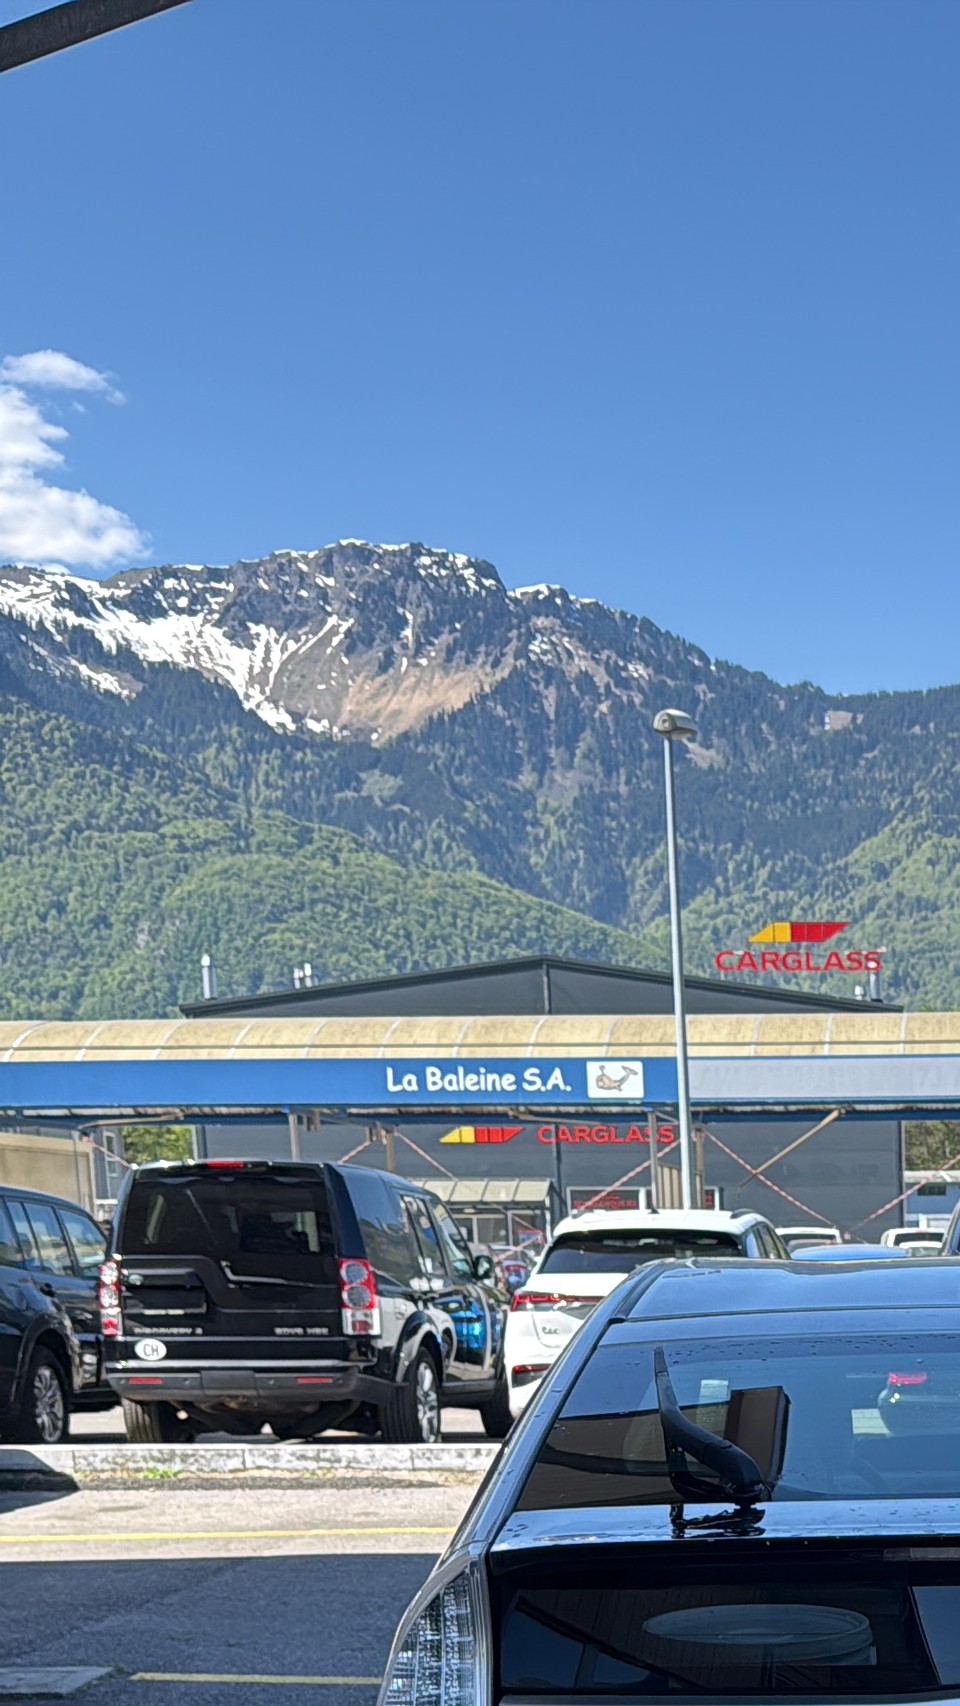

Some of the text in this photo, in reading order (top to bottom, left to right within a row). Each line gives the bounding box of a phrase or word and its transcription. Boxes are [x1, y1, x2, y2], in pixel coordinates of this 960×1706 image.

[714, 951, 882, 972] CARGLASS
[386, 1065, 572, 1092] La Baleine S.A.
[536, 1125, 675, 1144] CARGLASS
[143, 1343, 159, 1357] CH
